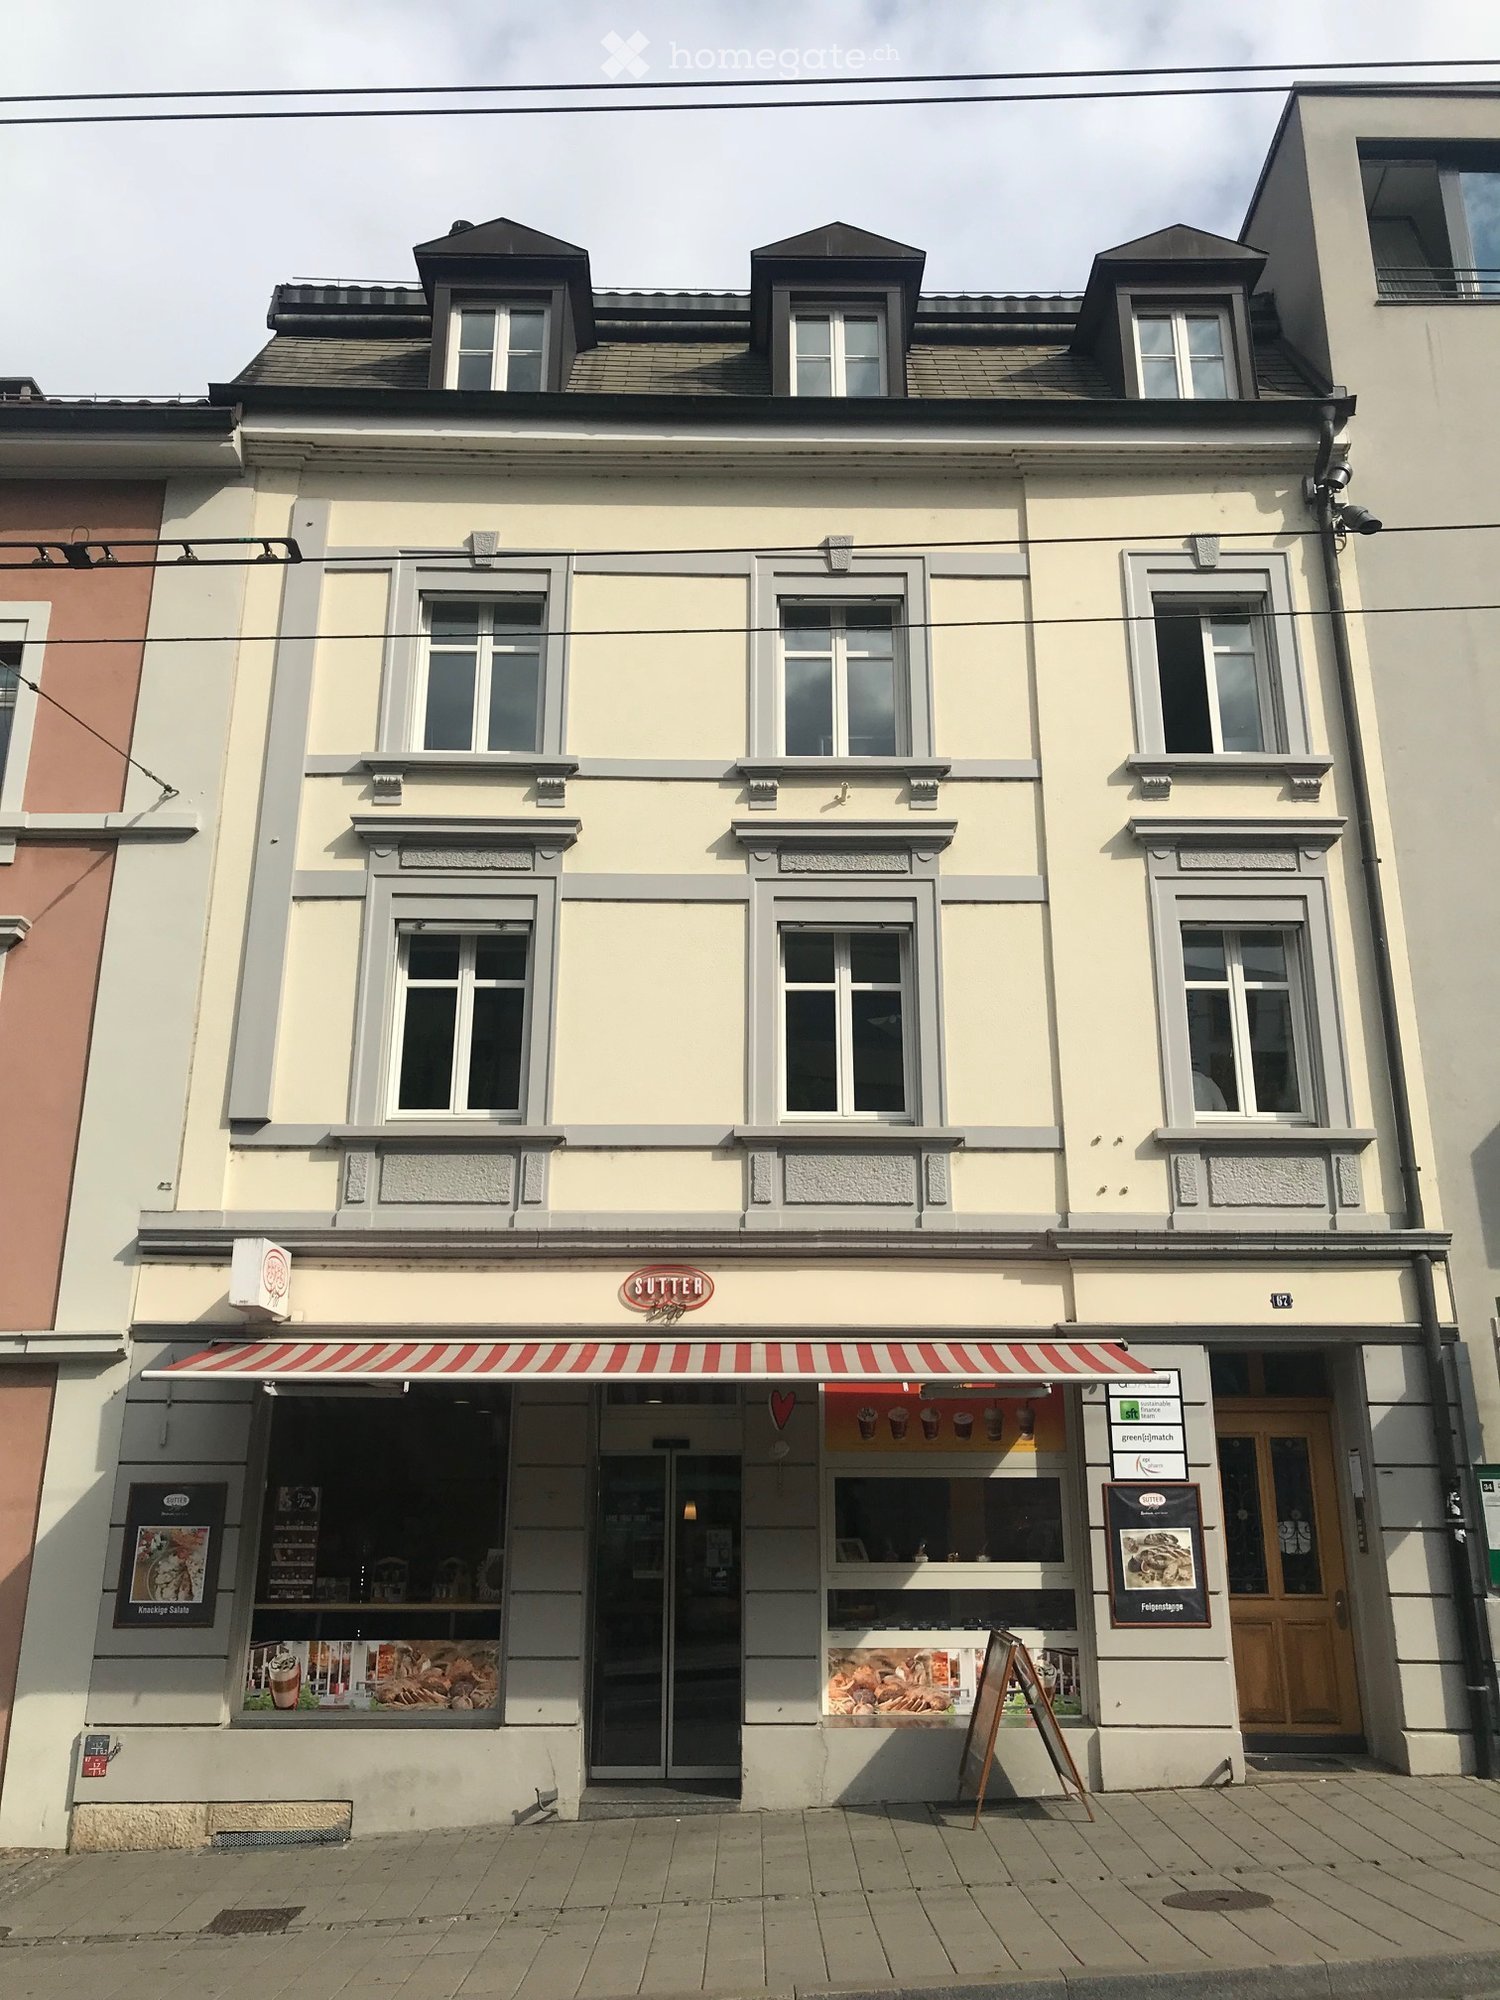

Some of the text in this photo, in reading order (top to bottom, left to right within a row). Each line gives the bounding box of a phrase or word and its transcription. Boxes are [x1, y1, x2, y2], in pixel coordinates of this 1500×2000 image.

[634, 1277, 704, 1295] SUTTER
[1276, 1295, 1288, 1307] 67
[1125, 1407, 1139, 1419] sft
[1483, 1483, 1493, 1491] 34
[138, 1605, 168, 1615] Knackige
[1141, 1602, 1184, 1613] Feigenstange
